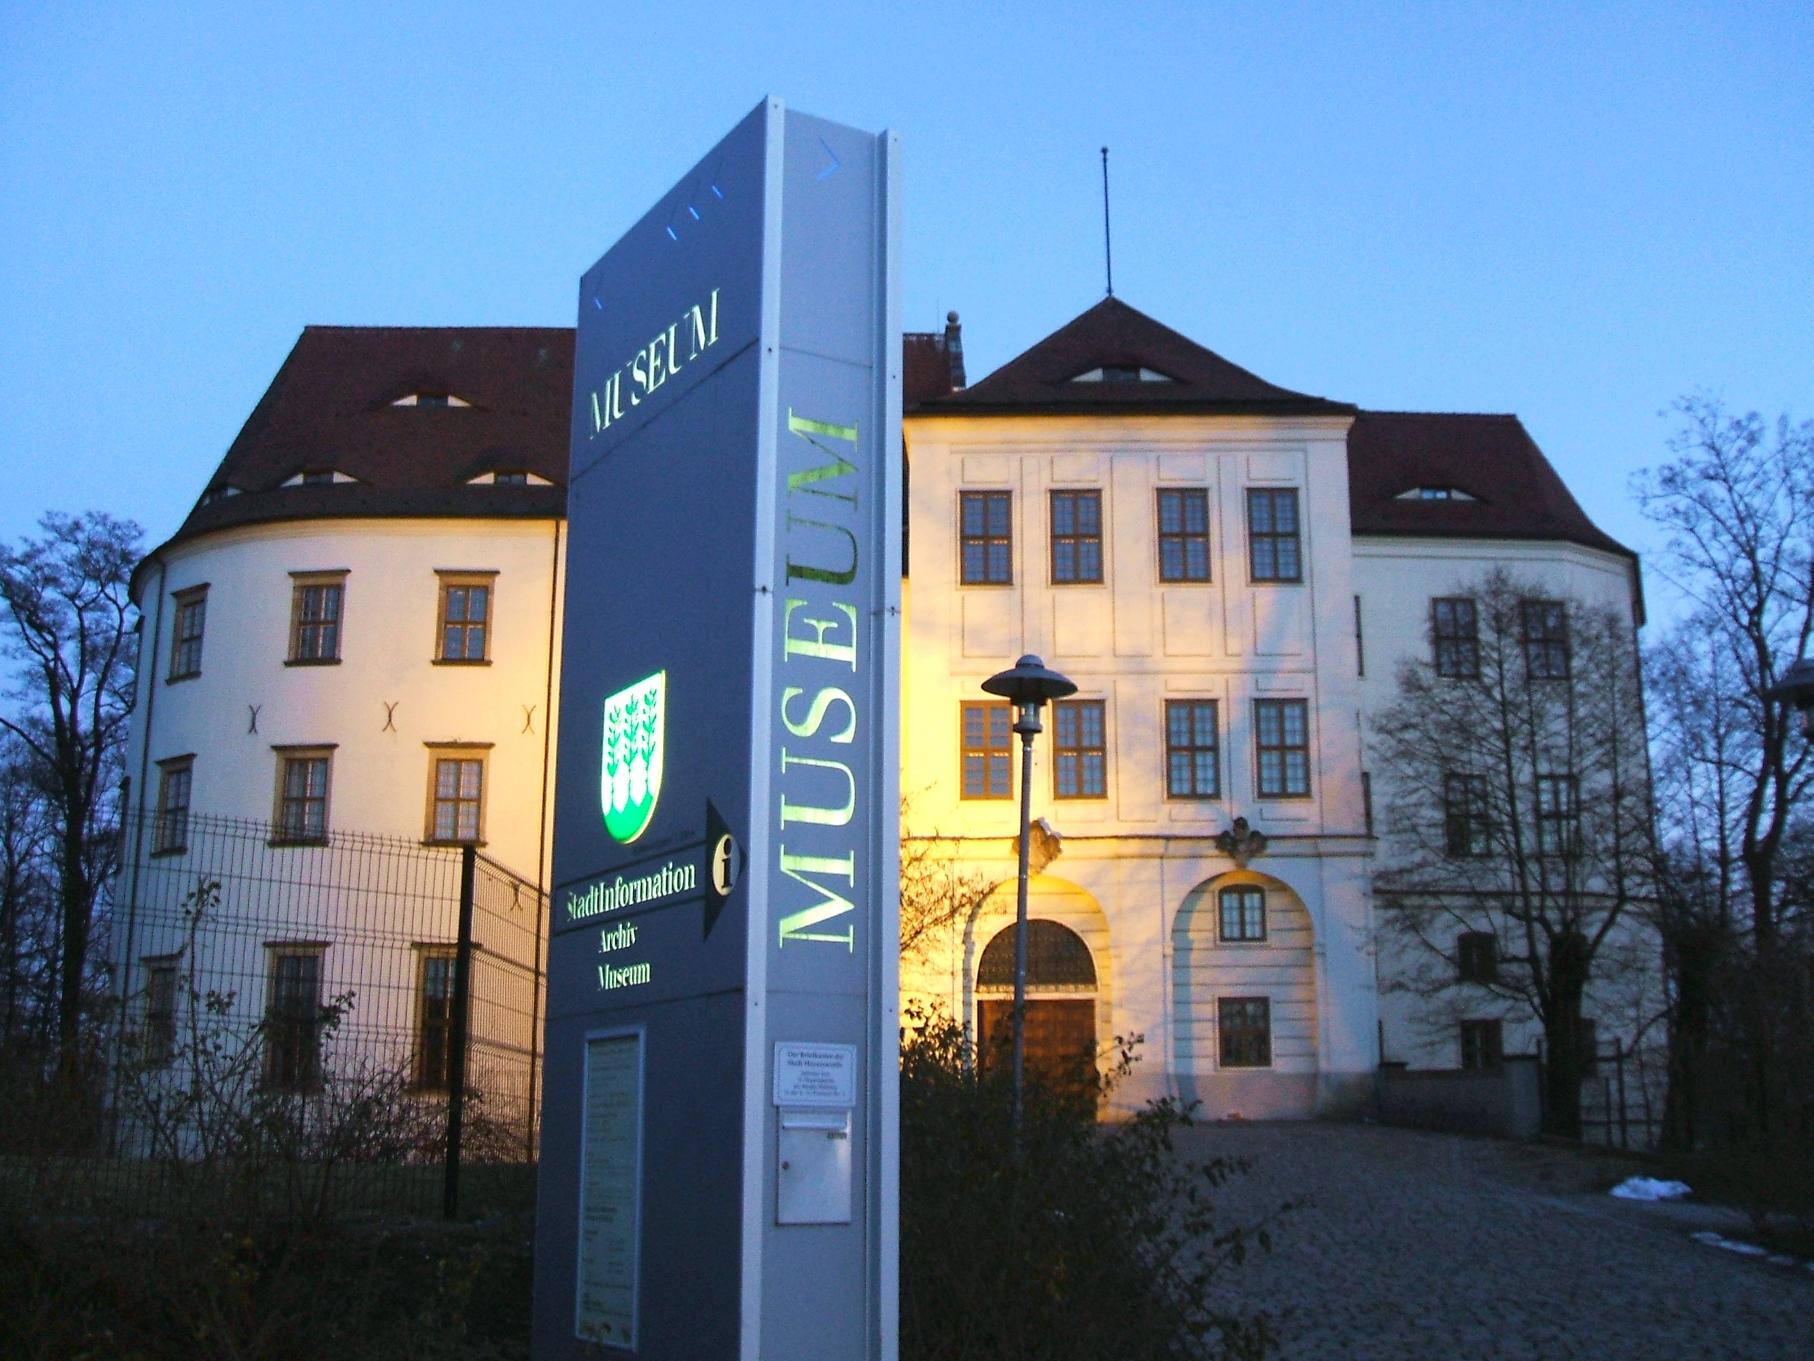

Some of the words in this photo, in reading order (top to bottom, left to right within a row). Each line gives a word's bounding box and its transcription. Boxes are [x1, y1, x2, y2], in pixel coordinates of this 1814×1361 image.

[589, 288, 720, 440] MUSEUM
[780, 406, 859, 954] MUSEUM
[598, 922, 638, 954] Archiv
[598, 962, 651, 991] Museum
